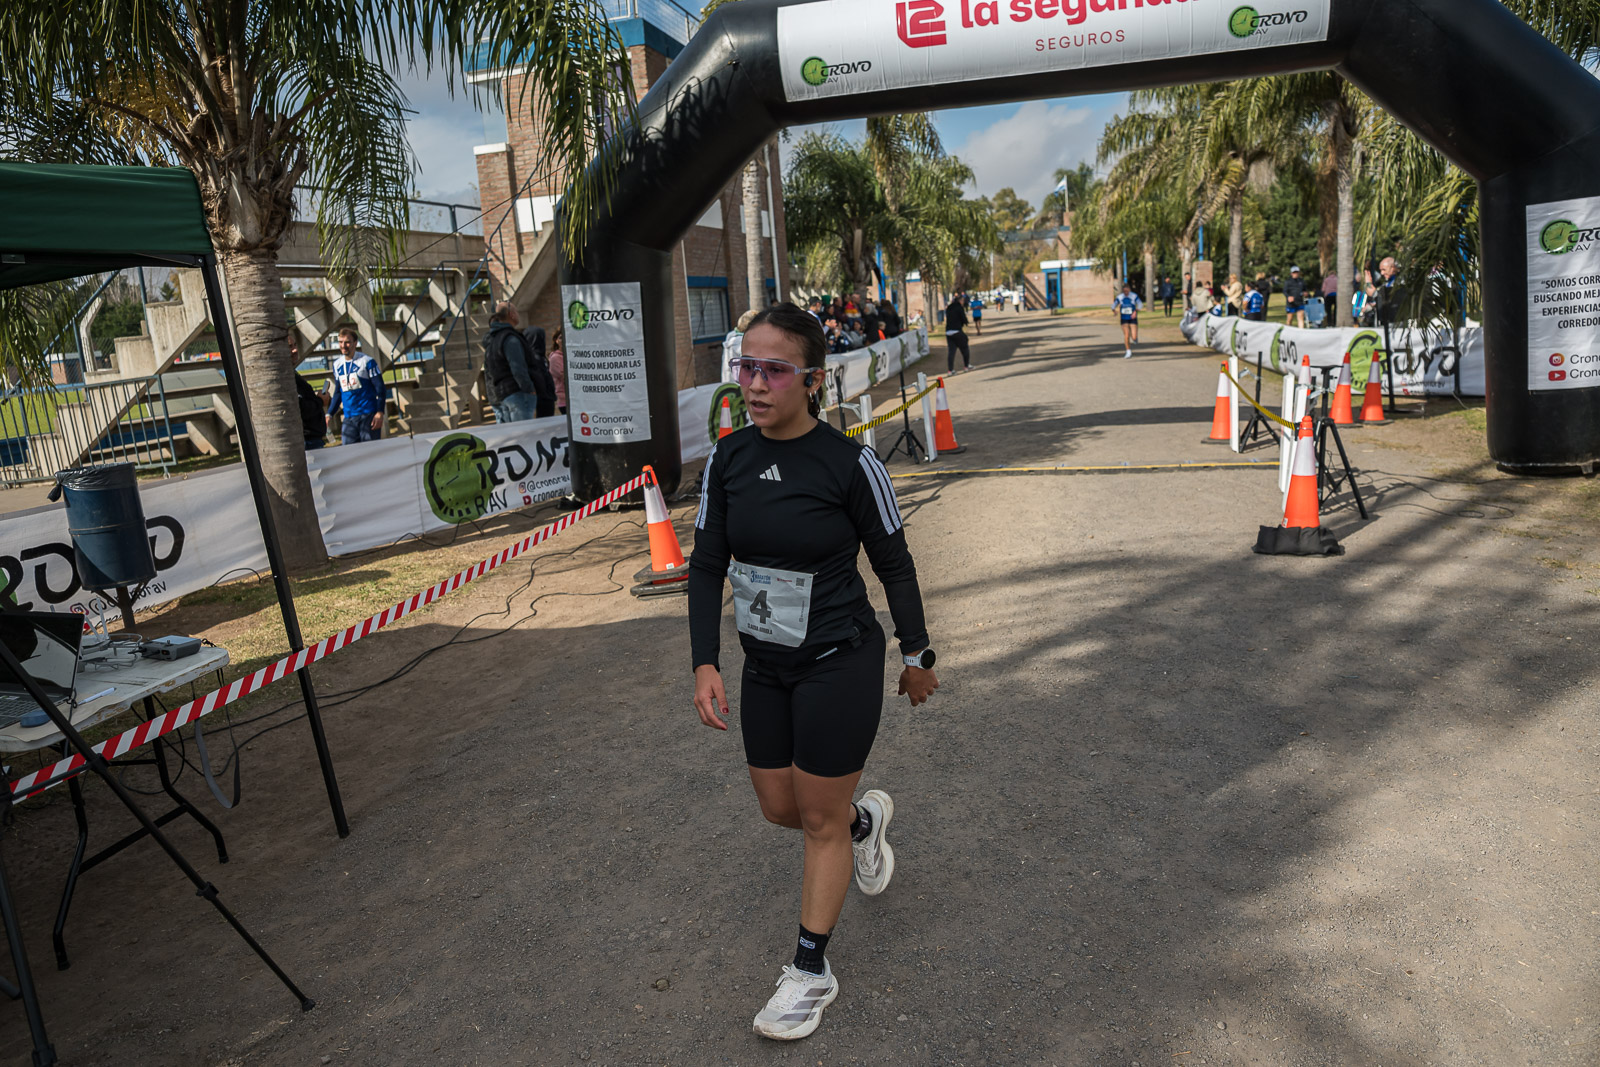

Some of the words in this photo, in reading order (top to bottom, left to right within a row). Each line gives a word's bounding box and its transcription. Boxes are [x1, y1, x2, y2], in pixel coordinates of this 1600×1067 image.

[960, 0, 999, 28] la
[1250, 10, 1308, 28] CRONO
[1035, 29, 1126, 52] SEGUROS
[820, 60, 872, 77] CRONO
[1565, 243, 1591, 253] RAV
[1533, 291, 1582, 304] BUSCANDO
[582, 308, 634, 322] CRONO
[592, 348, 635, 358] CORREDORES
[596, 360, 628, 370] MEJORAR
[629, 359, 641, 368] LAS
[574, 373, 612, 381] EXPERIENCIAS
[613, 372, 623, 380] DE
[624, 371, 636, 380] LOS
[592, 414, 633, 424] Cronorav
[593, 427, 634, 436] Cronorav
[527, 474, 570, 492] @cronorav
[474, 489, 508, 516] RAV
[533, 487, 567, 503] cronorav
[750, 590, 771, 624] 4
